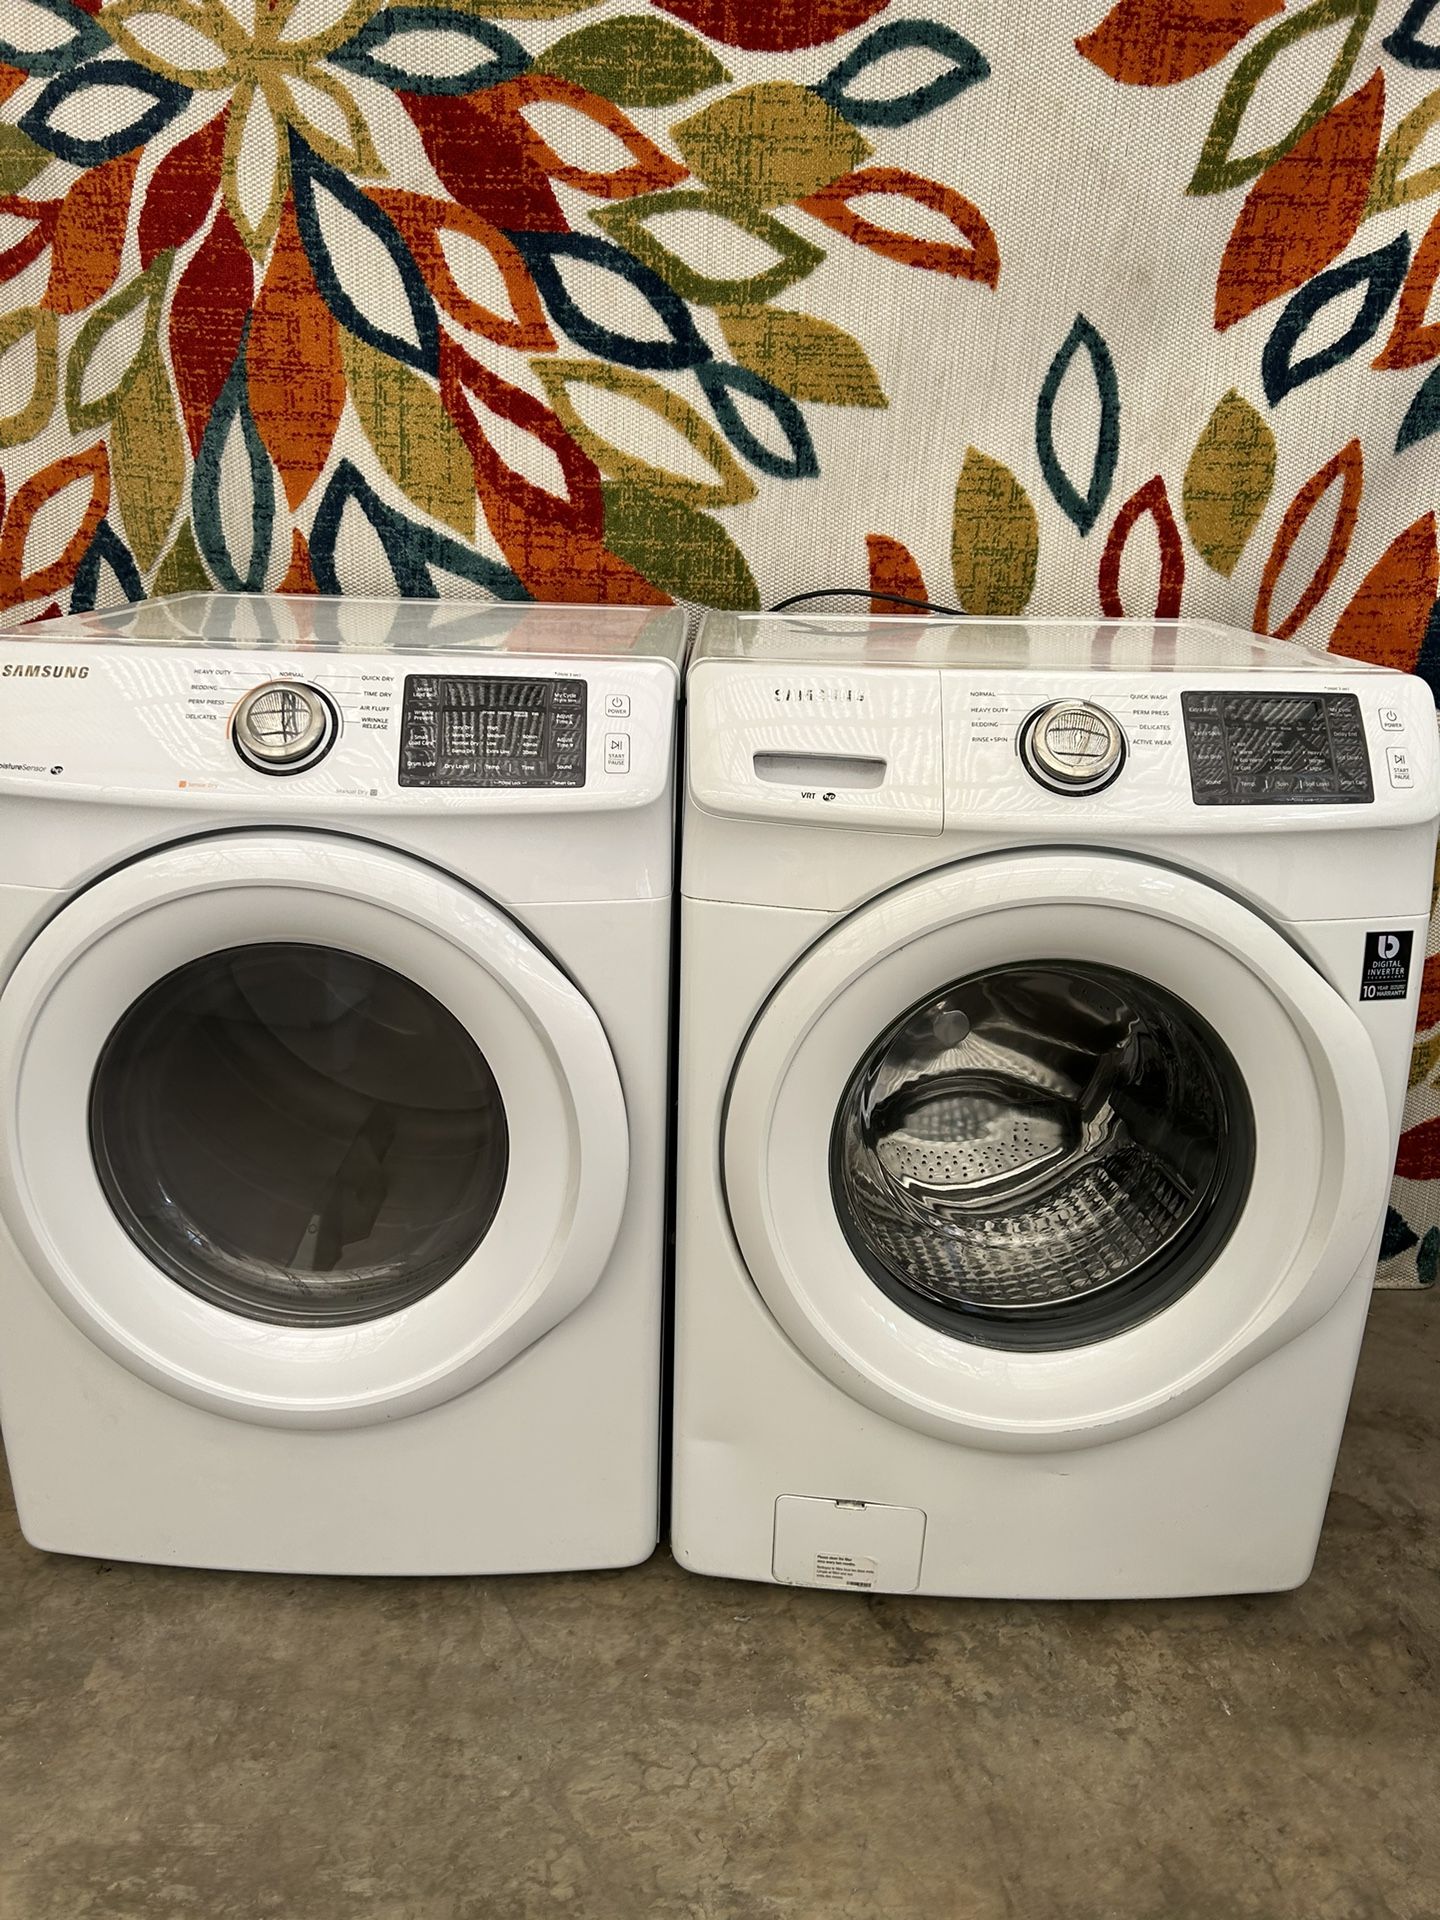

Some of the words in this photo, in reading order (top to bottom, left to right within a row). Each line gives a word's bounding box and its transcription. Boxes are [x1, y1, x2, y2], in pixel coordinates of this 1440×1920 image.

[2, 664, 90, 679] SAMSUNG
[1372, 960, 1401, 968] DIGITAL
[1367, 967, 1405, 976] INVERTER
[1363, 985, 1376, 998] 10
